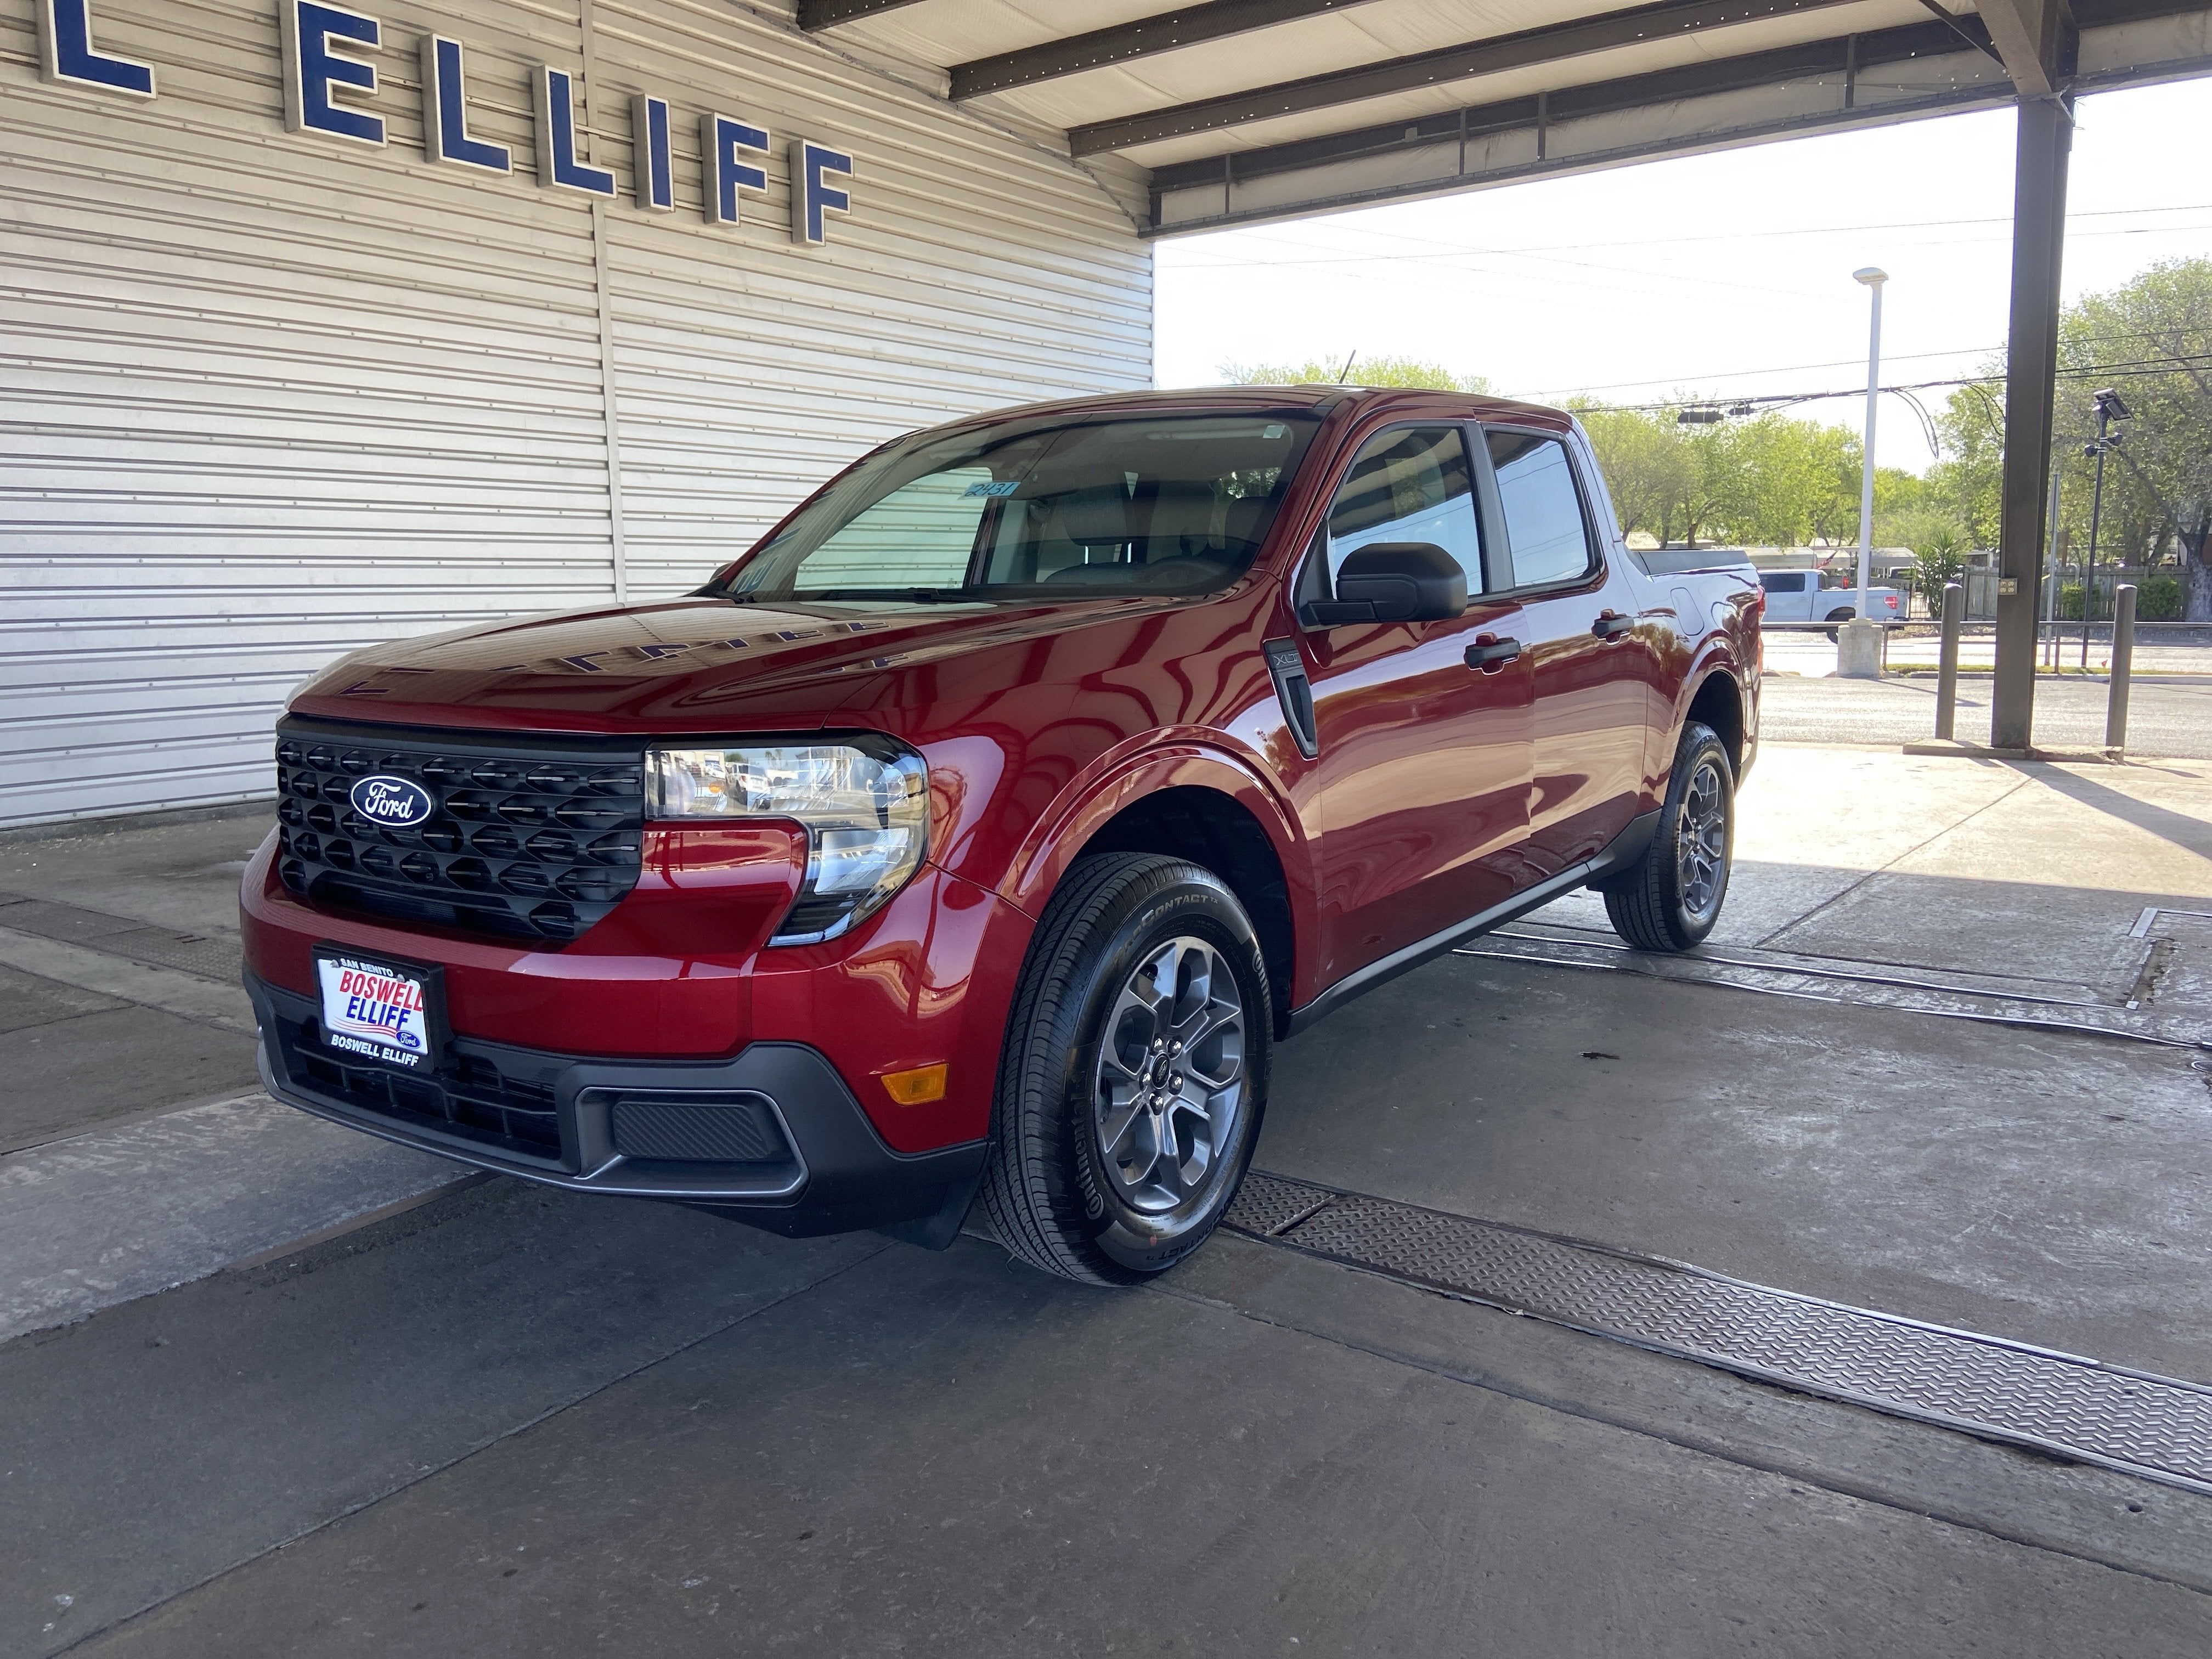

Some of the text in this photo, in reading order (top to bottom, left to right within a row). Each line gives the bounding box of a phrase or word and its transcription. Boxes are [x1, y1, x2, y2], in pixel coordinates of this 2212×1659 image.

[290, 0, 854, 246] ELLIFF
[964, 482, 1015, 496] 2431
[1273, 652, 1299, 665] XLT
[365, 781, 414, 819] Ford
[340, 958, 394, 977] SAN BENITO
[339, 970, 423, 1012] BOSWELL
[346, 996, 411, 1031] ELLIFF
[331, 1034, 419, 1066] BOSWELL ELLIFF
[399, 1032, 417, 1046] Ford
